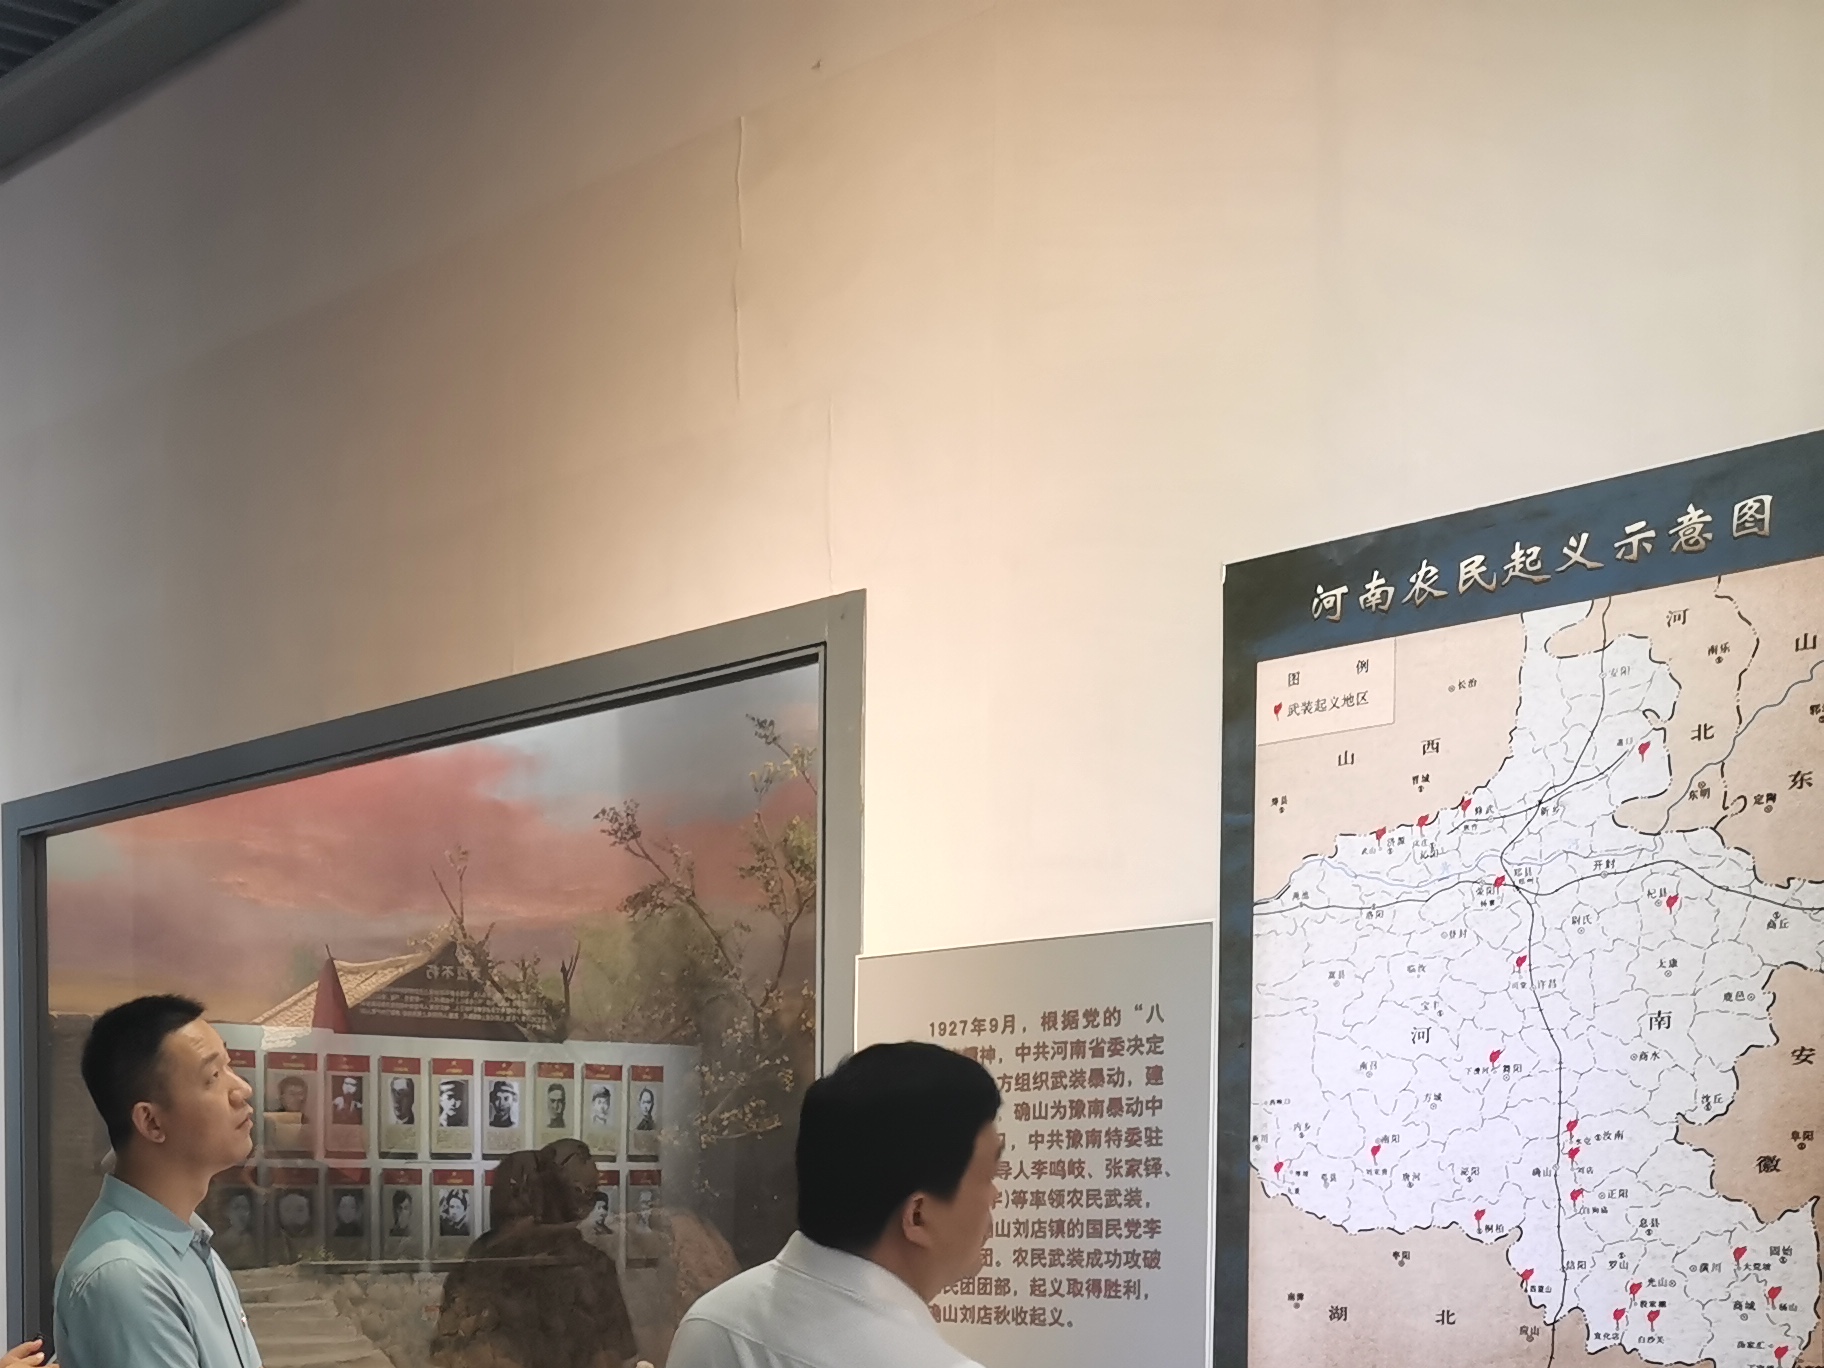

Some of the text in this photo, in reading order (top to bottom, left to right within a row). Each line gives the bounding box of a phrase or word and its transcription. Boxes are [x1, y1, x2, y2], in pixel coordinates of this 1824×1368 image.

[1310, 493, 1773, 623] 河南农民起义示意图
[1666, 608, 1690, 628] 河
[1794, 632, 1817, 652] 山
[1288, 659, 1369, 687] 图例
[1287, 690, 1369, 717] 武装起义地区
[1690, 723, 1715, 741] 北
[1421, 738, 1441, 755] 西
[1337, 750, 1355, 766] 山
[1787, 770, 1814, 790] 东
[1593, 859, 1616, 870] 开封
[1649, 1010, 1672, 1030] 南
[1411, 1027, 1432, 1044] 河
[1790, 1046, 1816, 1066] 安
[1756, 1155, 1782, 1174] 徽
[1329, 1306, 1348, 1322] 湖
[1435, 1310, 1456, 1326] 北
